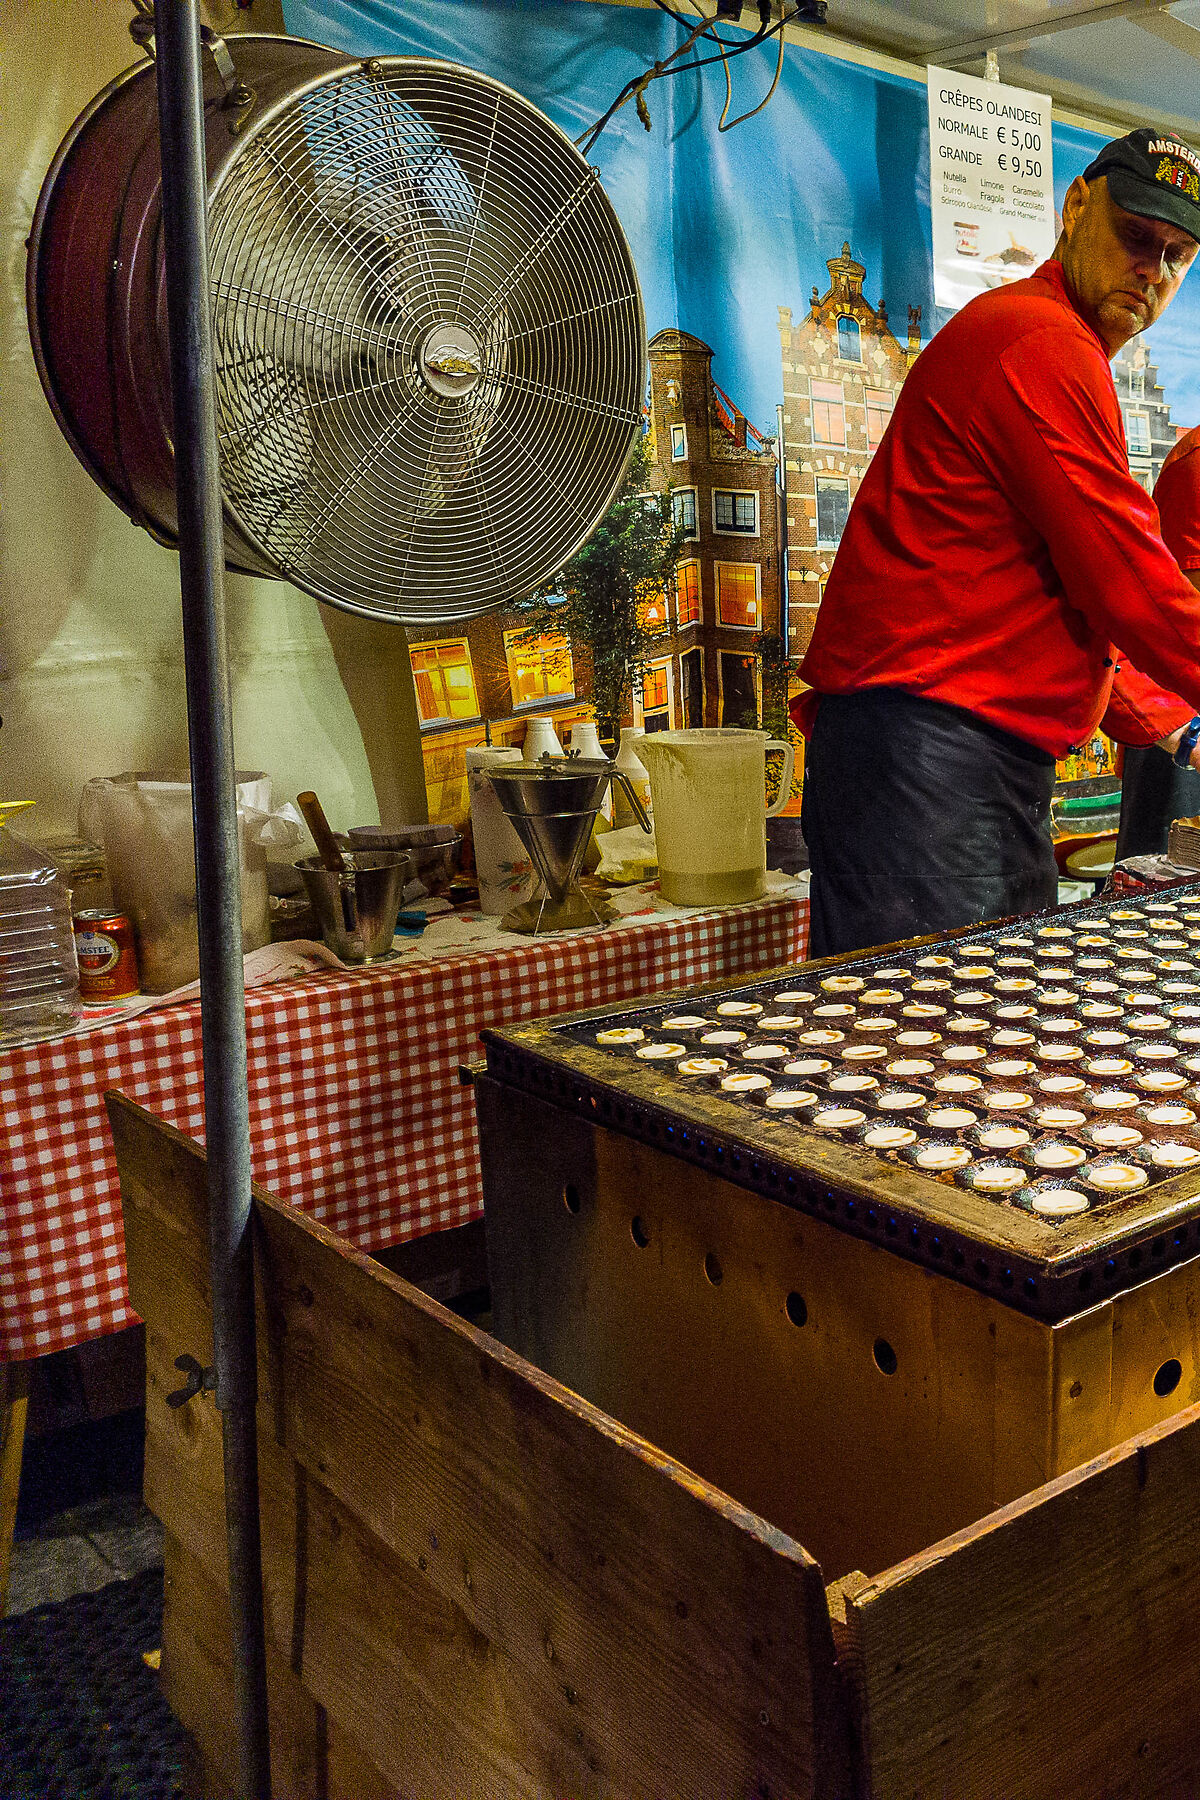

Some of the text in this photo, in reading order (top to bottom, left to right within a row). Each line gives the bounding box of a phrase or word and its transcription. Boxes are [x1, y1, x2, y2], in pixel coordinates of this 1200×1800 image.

[939, 88, 1042, 126] CRÊPES OLANDESI
[938, 117, 1041, 152] NORMALE € 5,00
[939, 145, 1042, 178] GRANDE € 9,50
[943, 171, 1044, 198] Nutella Limone Caramello
[943, 184, 1045, 211] Burro Fragola Cioccolato
